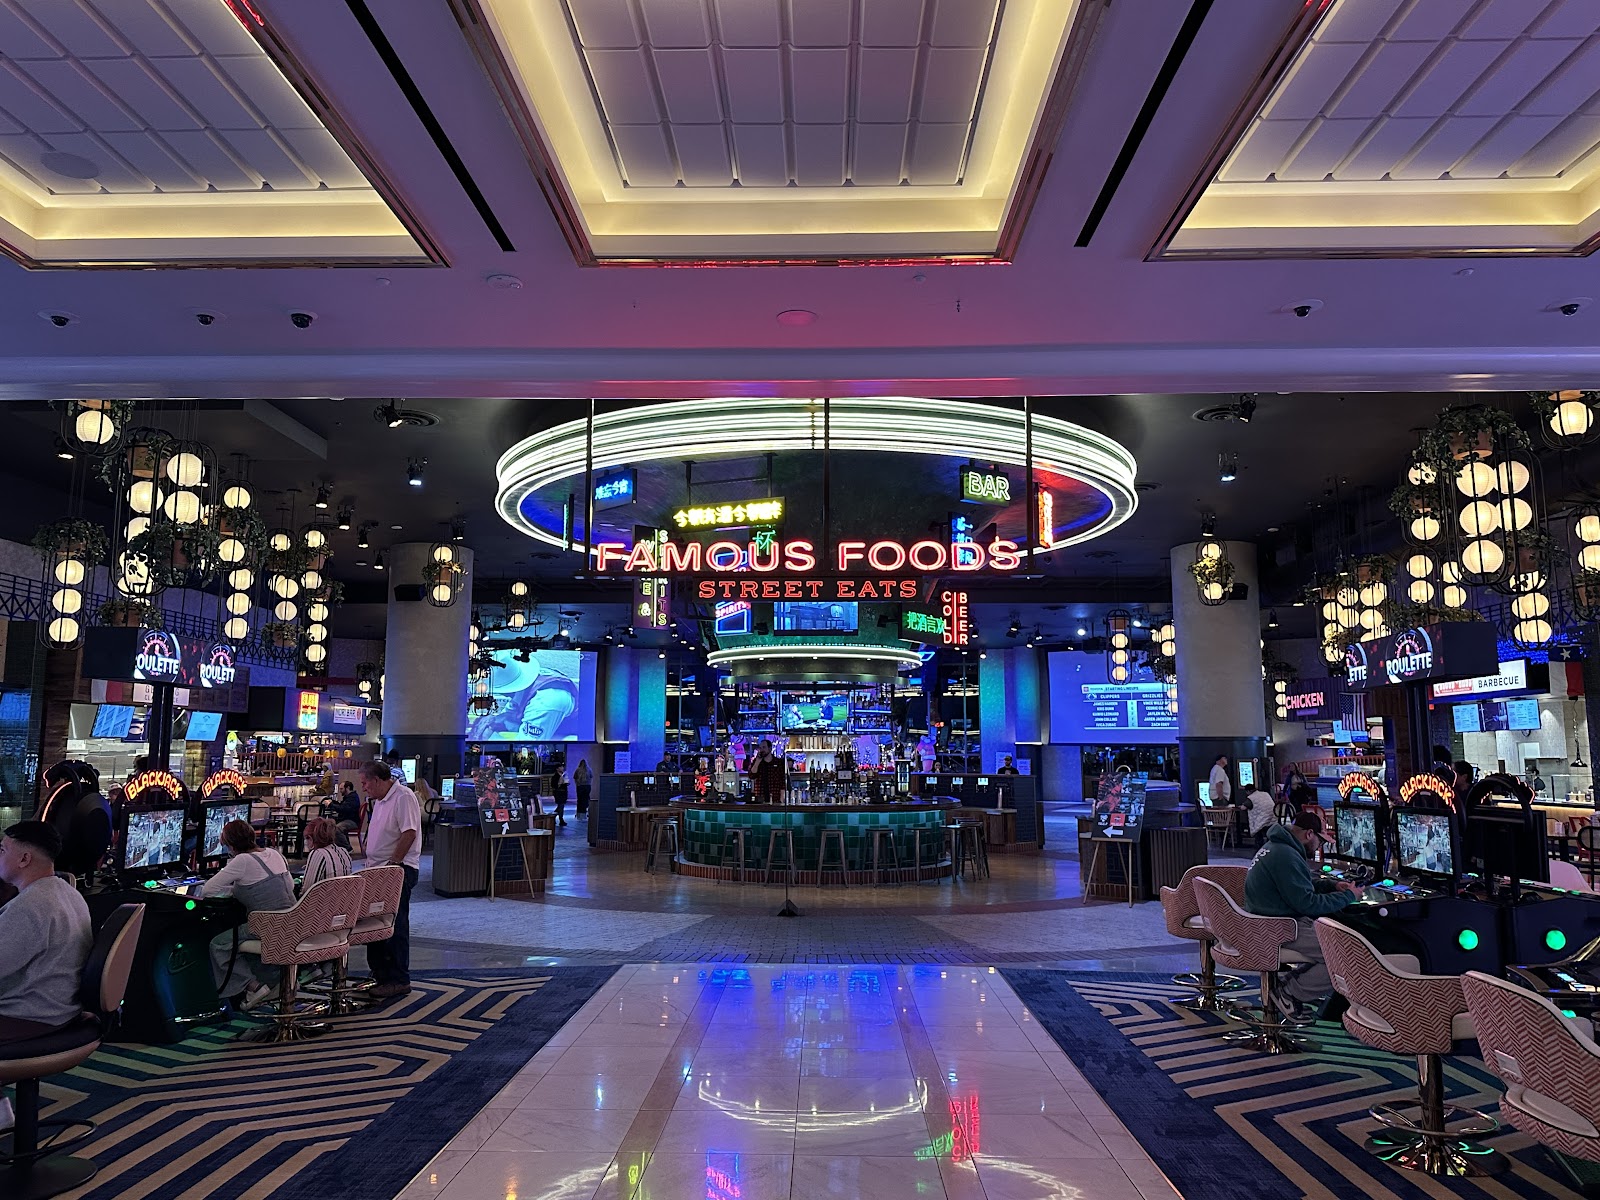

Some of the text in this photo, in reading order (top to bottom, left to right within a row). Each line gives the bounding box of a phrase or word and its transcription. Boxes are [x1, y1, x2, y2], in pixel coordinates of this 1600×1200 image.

[968, 471, 1011, 501] BAR
[597, 541, 1021, 572] FAMOUS FOODS
[698, 580, 917, 599] STREET EATS
[941, 590, 953, 644] COLD
[958, 592, 969, 645] BEER
[1347, 665, 1367, 683] ETTE
[1386, 651, 1433, 676] ROULETTE
[1478, 675, 1520, 689] BARBECUE
[1285, 692, 1325, 710] CHICKEN
[125, 769, 183, 800] BLACKJACK
[202, 770, 247, 798] BLACKJACK
[1338, 772, 1379, 800] BLACKJACK
[1400, 773, 1453, 806] BLACKJACK
